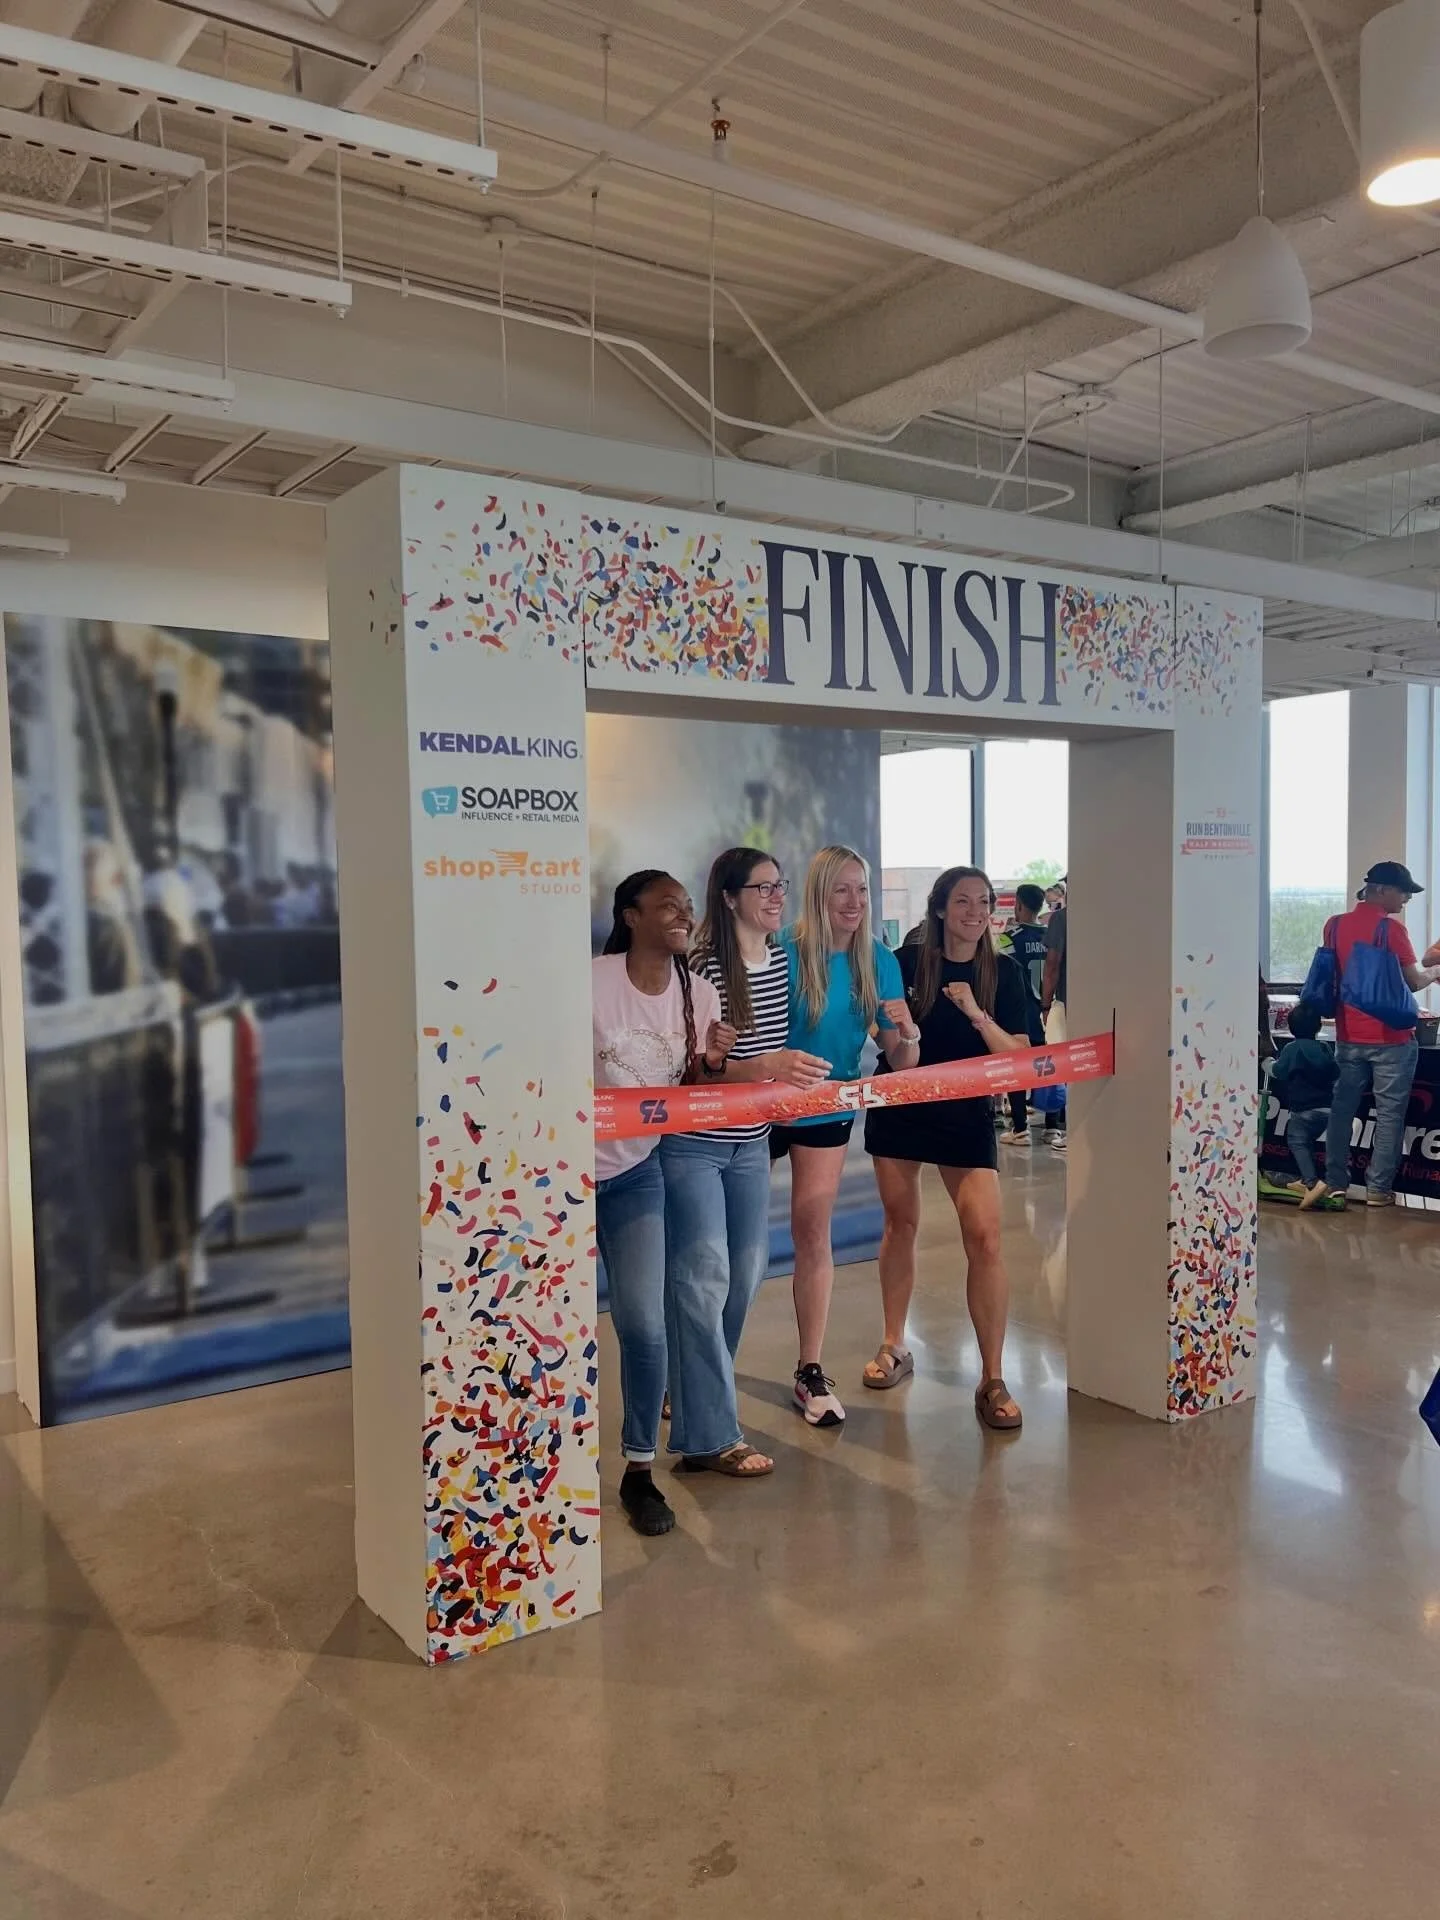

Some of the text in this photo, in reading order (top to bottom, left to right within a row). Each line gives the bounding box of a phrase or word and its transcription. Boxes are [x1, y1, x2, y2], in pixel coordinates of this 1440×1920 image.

[759, 539, 1061, 706] FINISH
[419, 731, 578, 759] KENDALKING
[461, 786, 579, 812] SOAPBOX
[461, 811, 513, 821] INFLUENCE
[522, 813, 550, 823] RETAIL
[552, 814, 580, 823] MEDIA
[1186, 822, 1251, 837] RUN BENTONVILLE
[424, 855, 581, 880] shop cart
[520, 883, 581, 895] STUDIO
